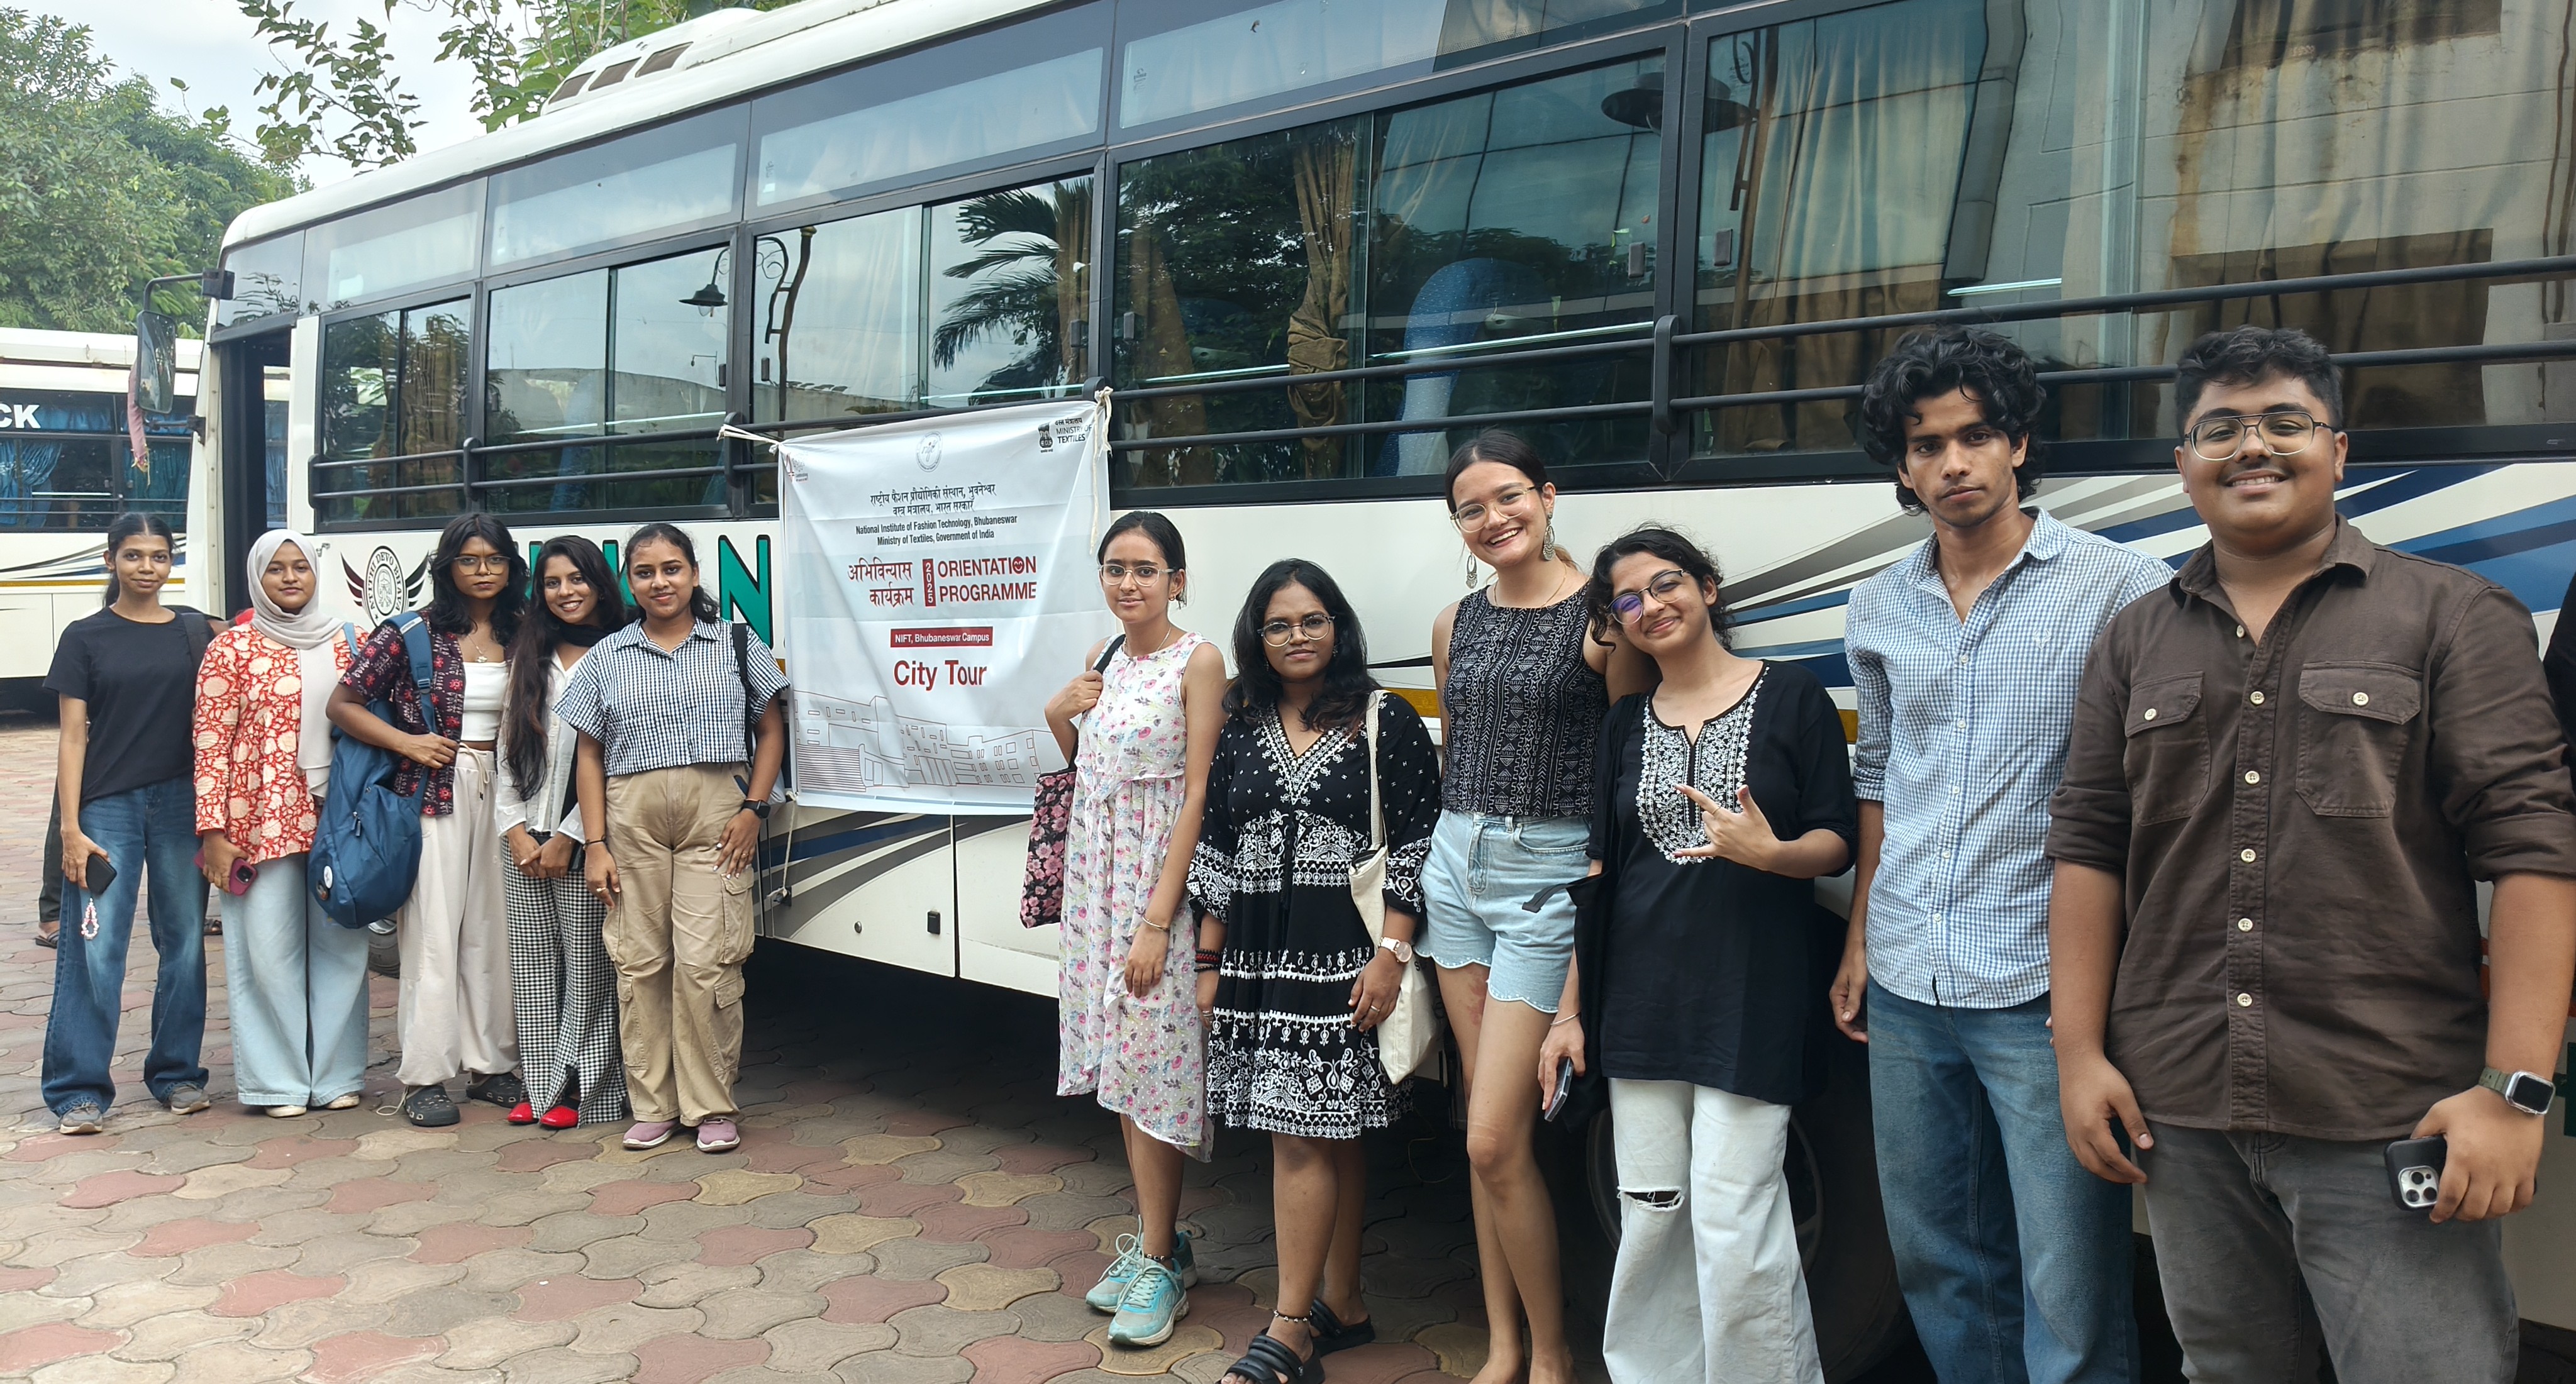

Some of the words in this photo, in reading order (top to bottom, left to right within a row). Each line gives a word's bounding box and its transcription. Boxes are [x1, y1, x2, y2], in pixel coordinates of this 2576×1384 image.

[1056, 425, 1082, 435] MINISTRY
[1084, 424, 1092, 432] OF
[1057, 433, 1085, 443] TEXTILES
[870, 490, 890, 507] राष्ट्रीय
[892, 489, 909, 503] फैशन
[910, 485, 941, 505] प्रौद्योगिकी
[943, 485, 965, 500] संस्थान,
[968, 482, 997, 500] भुवनेश्वर
[893, 506, 906, 517] वस्त्र
[935, 502, 952, 514] भारत
[953, 501, 975, 512] सरकार
[856, 524, 879, 534] National
[881, 523, 906, 533] Institute
[907, 522, 912, 531] of
[914, 521, 937, 531] Fashion
[938, 518, 973, 529] Technology,
[974, 516, 1018, 526] Bhubaneswar
[877, 536, 901, 546] Ministry
[902, 535, 908, 544] of
[909, 534, 935, 543] Textiles,
[936, 531, 970, 541] Government
[972, 530, 978, 540] of
[979, 529, 994, 538] India
[847, 556, 913, 582] अभिविन्यास
[938, 556, 1036, 578] ORIENTATION
[368, 561, 377, 610] ATITHI
[375, 551, 394, 565] DEVO
[393, 565, 402, 611] BHAVA
[924, 562, 934, 604] 2025
[870, 582, 914, 607] कार्यक्रम
[939, 582, 1037, 602] PROGRAMME
[895, 634, 913, 644] NIFT,
[914, 634, 961, 643] Bhubaneswar
[962, 633, 989, 643] Campus
[894, 660, 938, 691] City
[945, 660, 987, 685] Tour
